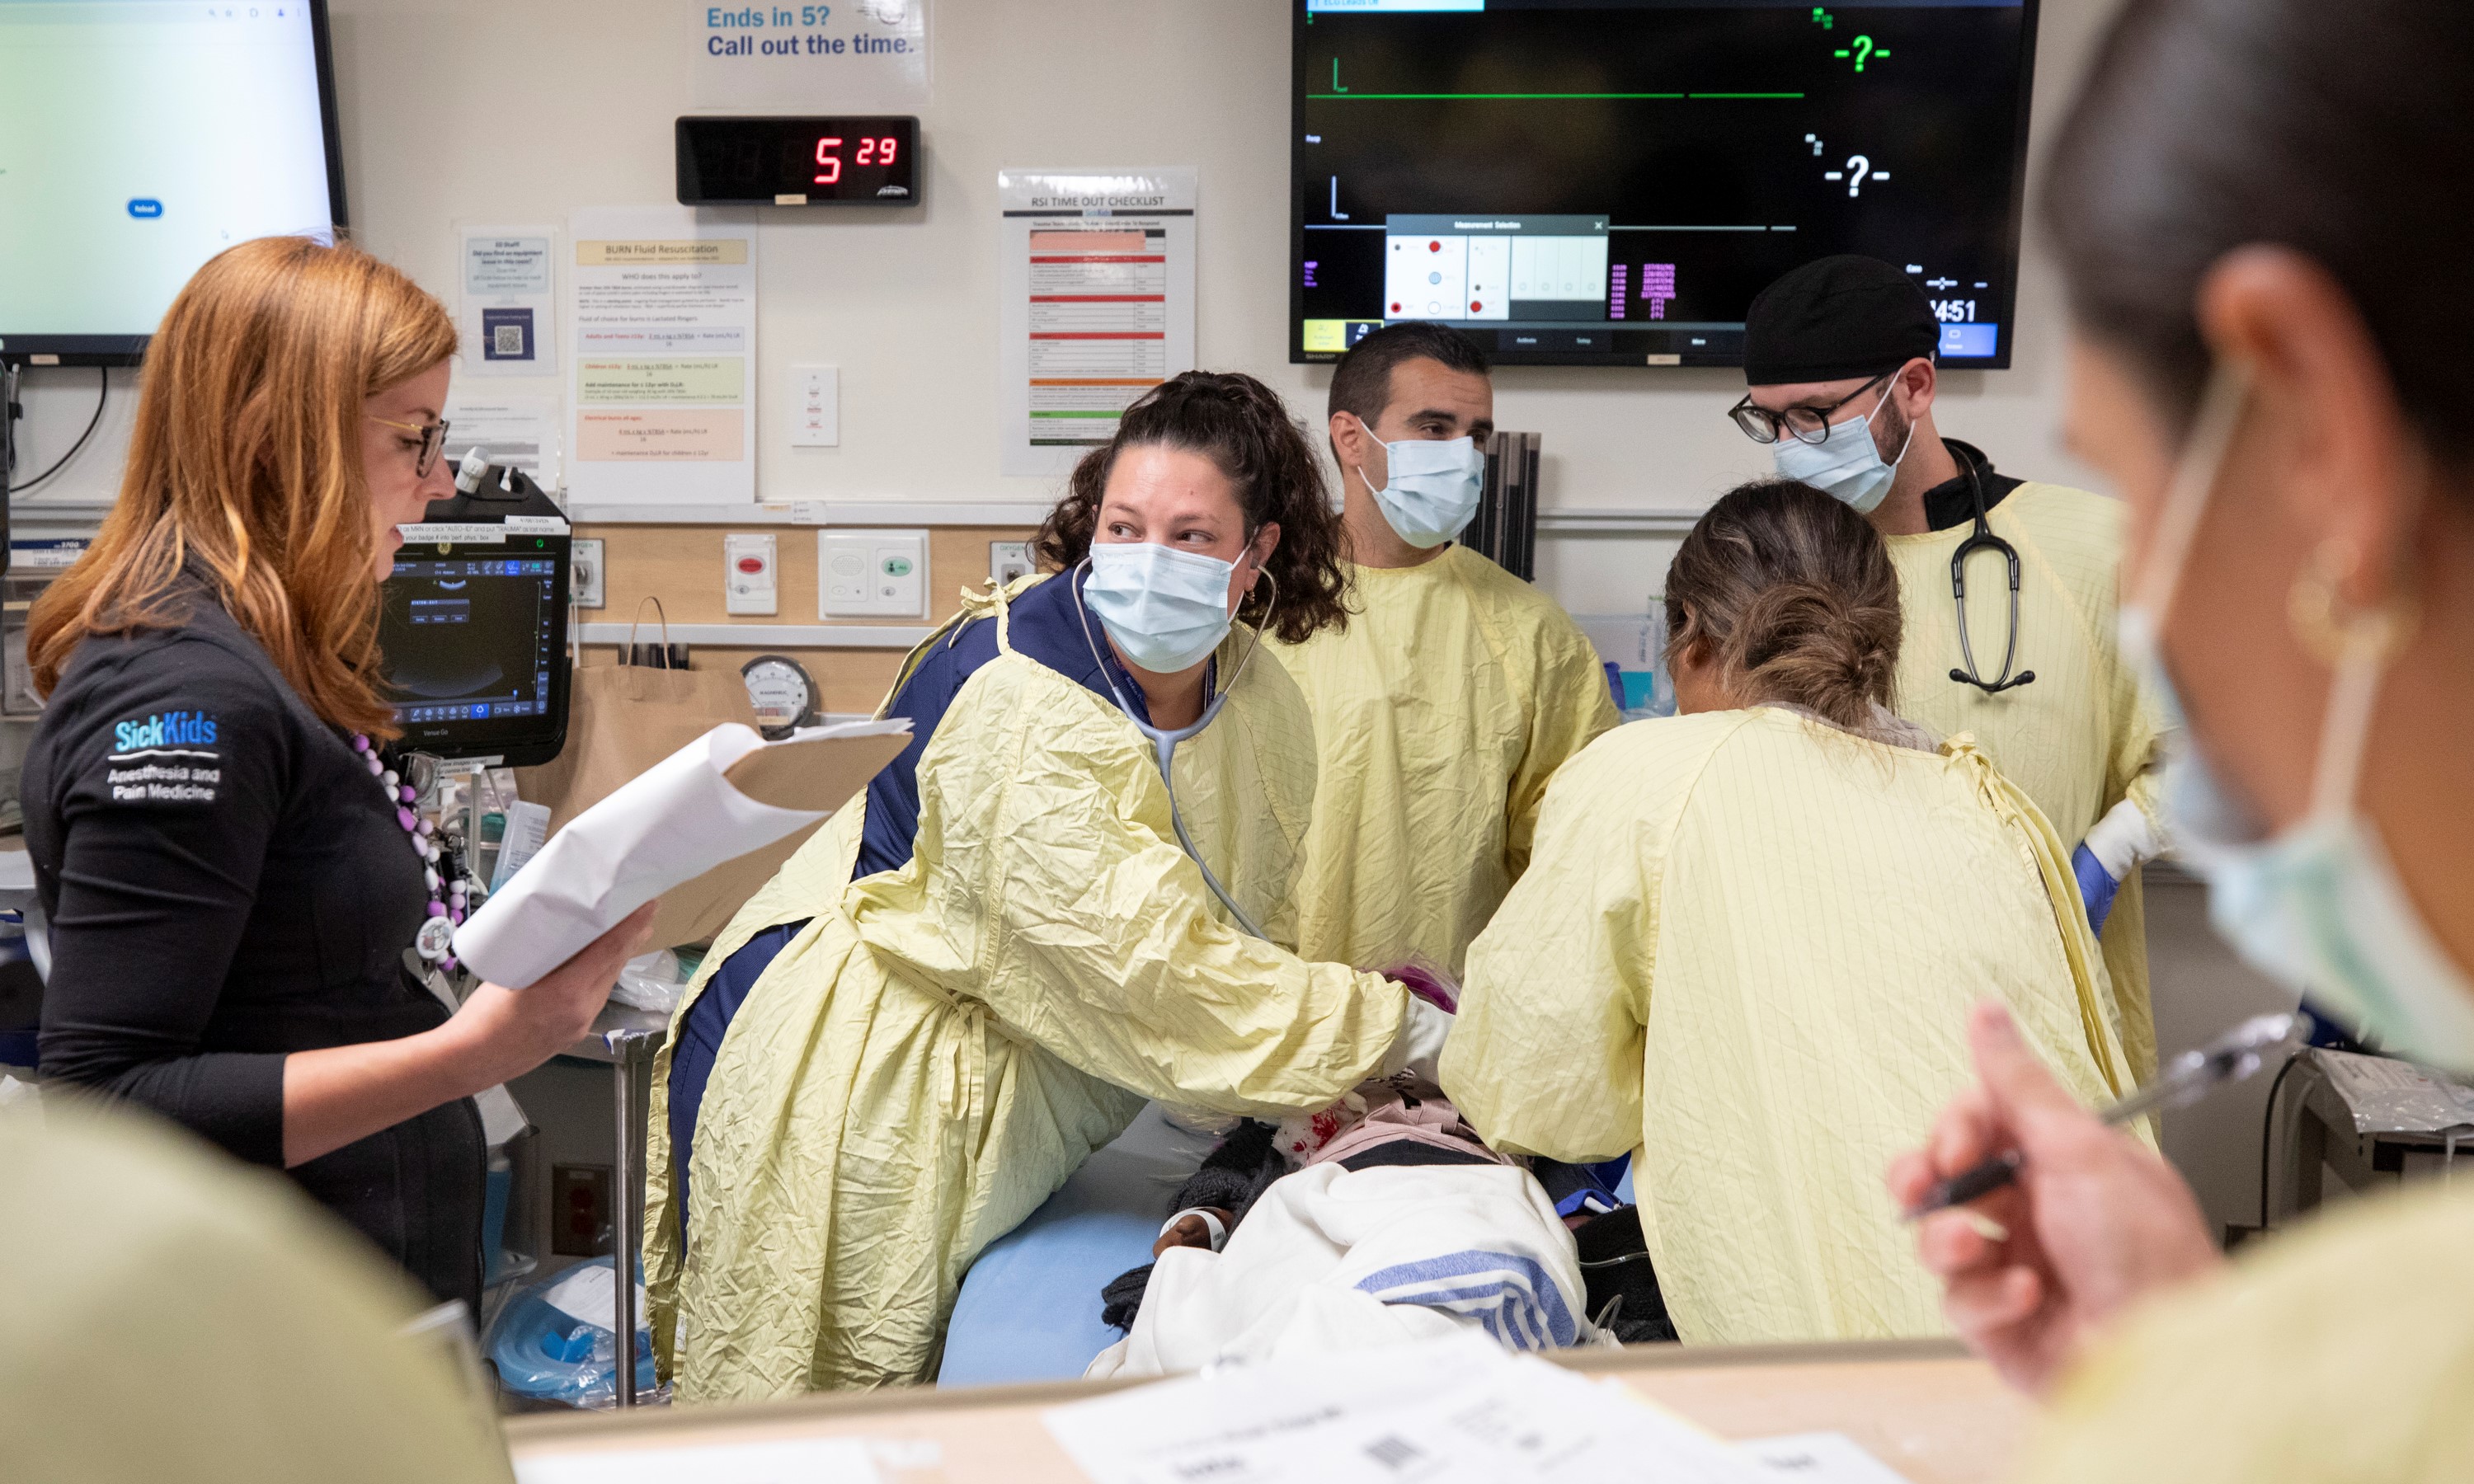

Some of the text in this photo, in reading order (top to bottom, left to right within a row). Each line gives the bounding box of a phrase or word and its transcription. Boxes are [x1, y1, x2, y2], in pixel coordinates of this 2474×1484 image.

[707, 6, 830, 28] Ends in 5?
[708, 34, 915, 55] Call out the time.
[814, 138, 897, 185] 5 29
[1031, 196, 1164, 207] RSI TIME OUT CHECKLIST
[1454, 222, 1521, 230] Measurement Selection
[605, 244, 718, 254] BURN Fluid Resuscitation
[672, 273, 689, 282] apply
[691, 272, 703, 280] to?
[677, 315, 698, 323] Ringers
[496, 525, 522, 533] "TRAUMA"
[115, 710, 218, 753] SickKids
[107, 763, 221, 784] Anesthesia and
[113, 783, 216, 801] Pain Medicine
